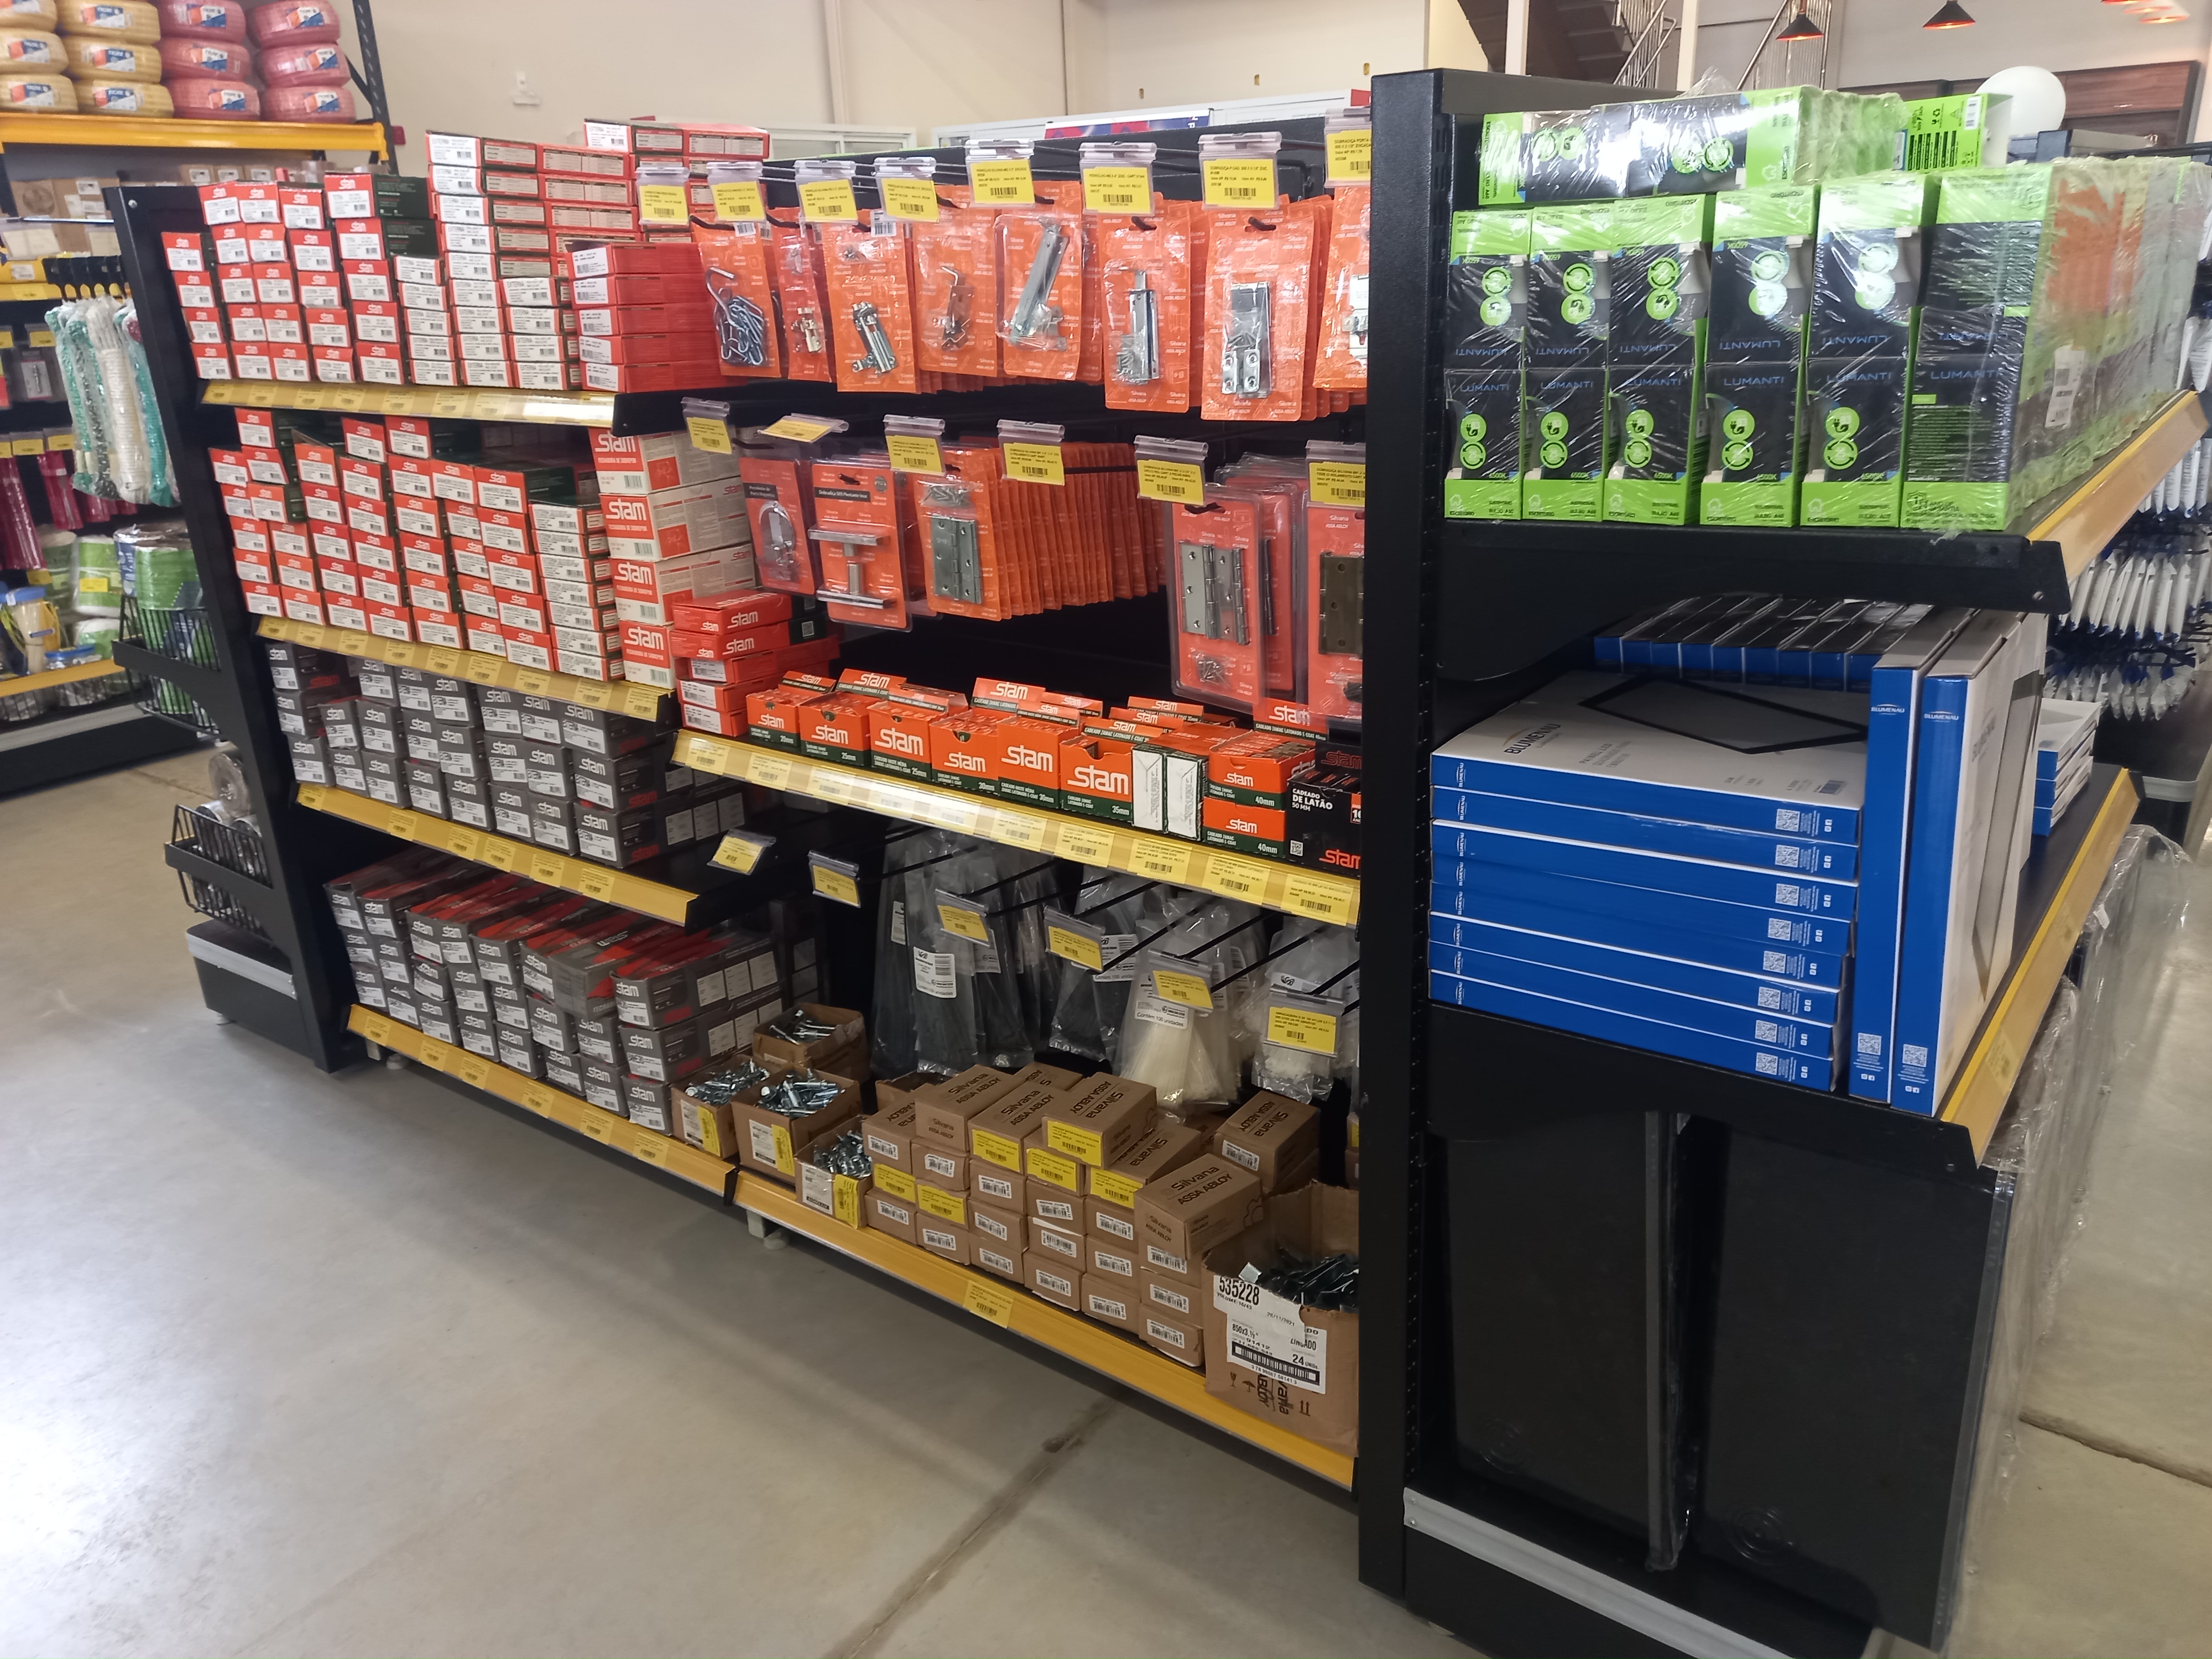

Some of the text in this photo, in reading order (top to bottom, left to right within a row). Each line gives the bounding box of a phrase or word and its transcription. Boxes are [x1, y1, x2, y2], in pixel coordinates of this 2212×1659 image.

[1719, 340, 1781, 350] LUMANTI
[1724, 376, 1785, 386] LUMANTI
[1827, 372, 1891, 382] LUMANTI
[400, 421, 415, 432] stam
[595, 431, 636, 452] stam
[442, 465, 460, 476] stam
[491, 472, 507, 484] stam
[409, 499, 423, 510] stam
[606, 498, 646, 520] stam
[415, 539, 430, 551] stam
[500, 554, 518, 566] stam
[614, 561, 653, 585] stam
[429, 612, 445, 624] stam
[727, 611, 758, 629] stam
[701, 621, 719, 632] stam
[517, 632, 534, 644] stam
[624, 626, 664, 650] stam
[697, 648, 714, 659] stam
[722, 637, 755, 655] stam
[269, 648, 288, 660] stam
[435, 678, 458, 692] stam
[796, 674, 822, 685] stam
[853, 672, 890, 688] stam
[485, 690, 511, 703] stam
[990, 682, 1028, 700] stam
[1061, 696, 1081, 706] stam
[1151, 700, 1178, 712] stam
[326, 708, 345, 721] stam
[565, 705, 594, 721] stam
[1038, 704, 1058, 714] stam
[1269, 706, 1310, 726] stam
[410, 718, 431, 733] stam
[758, 713, 784, 729] stam
[1133, 712, 1158, 724] stam
[811, 724, 848, 744] stam
[1084, 727, 1100, 735] CADEADO
[1113, 732, 1131, 740] LATONADO
[1109, 721, 1136, 733] stam
[441, 729, 464, 745] stam
[874, 727, 924, 756] stam
[1504, 723, 1561, 754] BLUMENAU
[293, 741, 315, 754] stam
[491, 741, 517, 756] stam
[529, 749, 555, 766] stam
[842, 752, 856, 761] 25mm
[944, 752, 986, 773] stam
[1001, 745, 1053, 773] stam
[579, 758, 606, 776] stam
[1067, 765, 1129, 795] stam
[1224, 772, 1253, 786] stam
[452, 780, 477, 795] stam
[1292, 788, 1321, 800] CADEADO
[499, 791, 522, 807] stam
[1255, 796, 1275, 807] 40mm
[1305, 799, 1333, 810] LATÃO
[1112, 805, 1129, 815] 35mm
[582, 814, 608, 831] stam
[1225, 818, 1257, 834] stam
[1258, 843, 1277, 854] 40mm
[364, 902, 384, 915] stam
[442, 926, 462, 938] stam
[478, 943, 501, 957] stam
[525, 954, 547, 974] stam
[495, 986, 518, 1001] stam
[616, 982, 639, 997] stam
[534, 1006, 557, 1025] stam
[1164, 1018, 1183, 1027] unidades
[628, 1034, 653, 1050] stam
[587, 1066, 611, 1083] stam
[948, 1073, 989, 1094] Silvana
[956, 1077, 1001, 1104] ASSA ABLOY
[630, 1086, 655, 1103] stam
[1070, 1081, 1112, 1114] ASSA ABLOY
[1000, 1091, 1041, 1115] Silvana
[1010, 1094, 1055, 1125] ASSA ABLOY
[1086, 1092, 1124, 1119] Silvana
[1238, 1114, 1261, 1131] ABLOY
[1254, 1111, 1288, 1137] Silvana
[1130, 1138, 1168, 1166] Silvana
[1171, 1166, 1219, 1191] Silvana
[1178, 1173, 1233, 1205] ASSA ABLOY
[1219, 1276, 1259, 1305] 535228
[1292, 1354, 1304, 1365] 24
